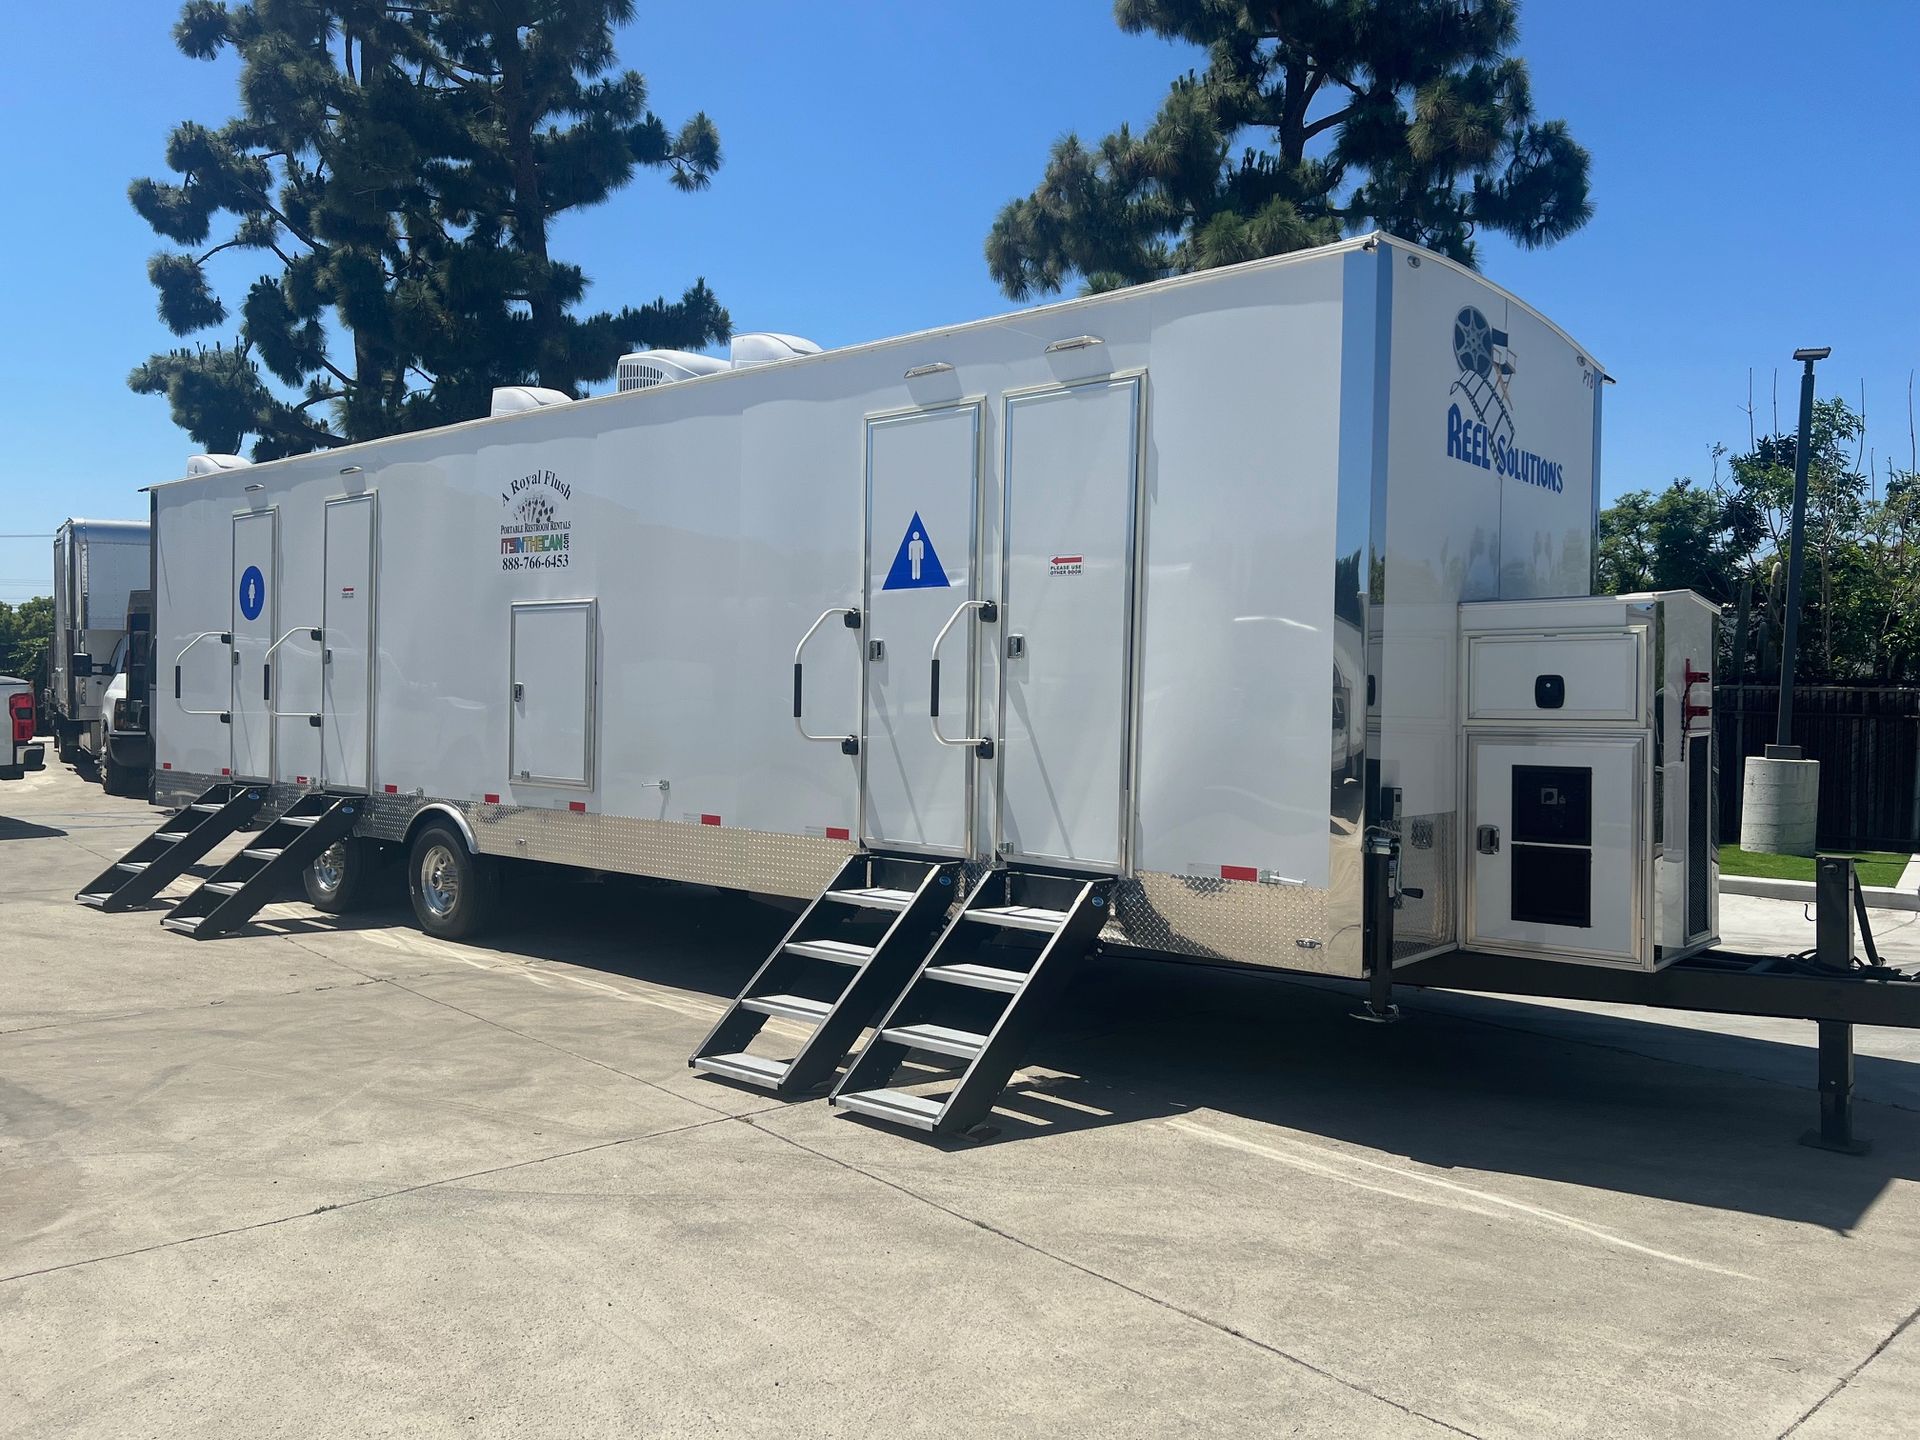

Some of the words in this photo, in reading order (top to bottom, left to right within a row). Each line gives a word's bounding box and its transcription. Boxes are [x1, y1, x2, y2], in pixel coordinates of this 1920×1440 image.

[1447, 403, 1491, 470] REEL
[1496, 435, 1564, 494] SOLUTIONS
[501, 492, 511, 507] A
[510, 469, 541, 495] Royal
[543, 470, 572, 500] Flush
[501, 525, 523, 535] PORTABLE
[524, 522, 550, 532] RESTROOM
[550, 520, 571, 530] RENTALS
[502, 554, 569, 571] 888-766-6453
